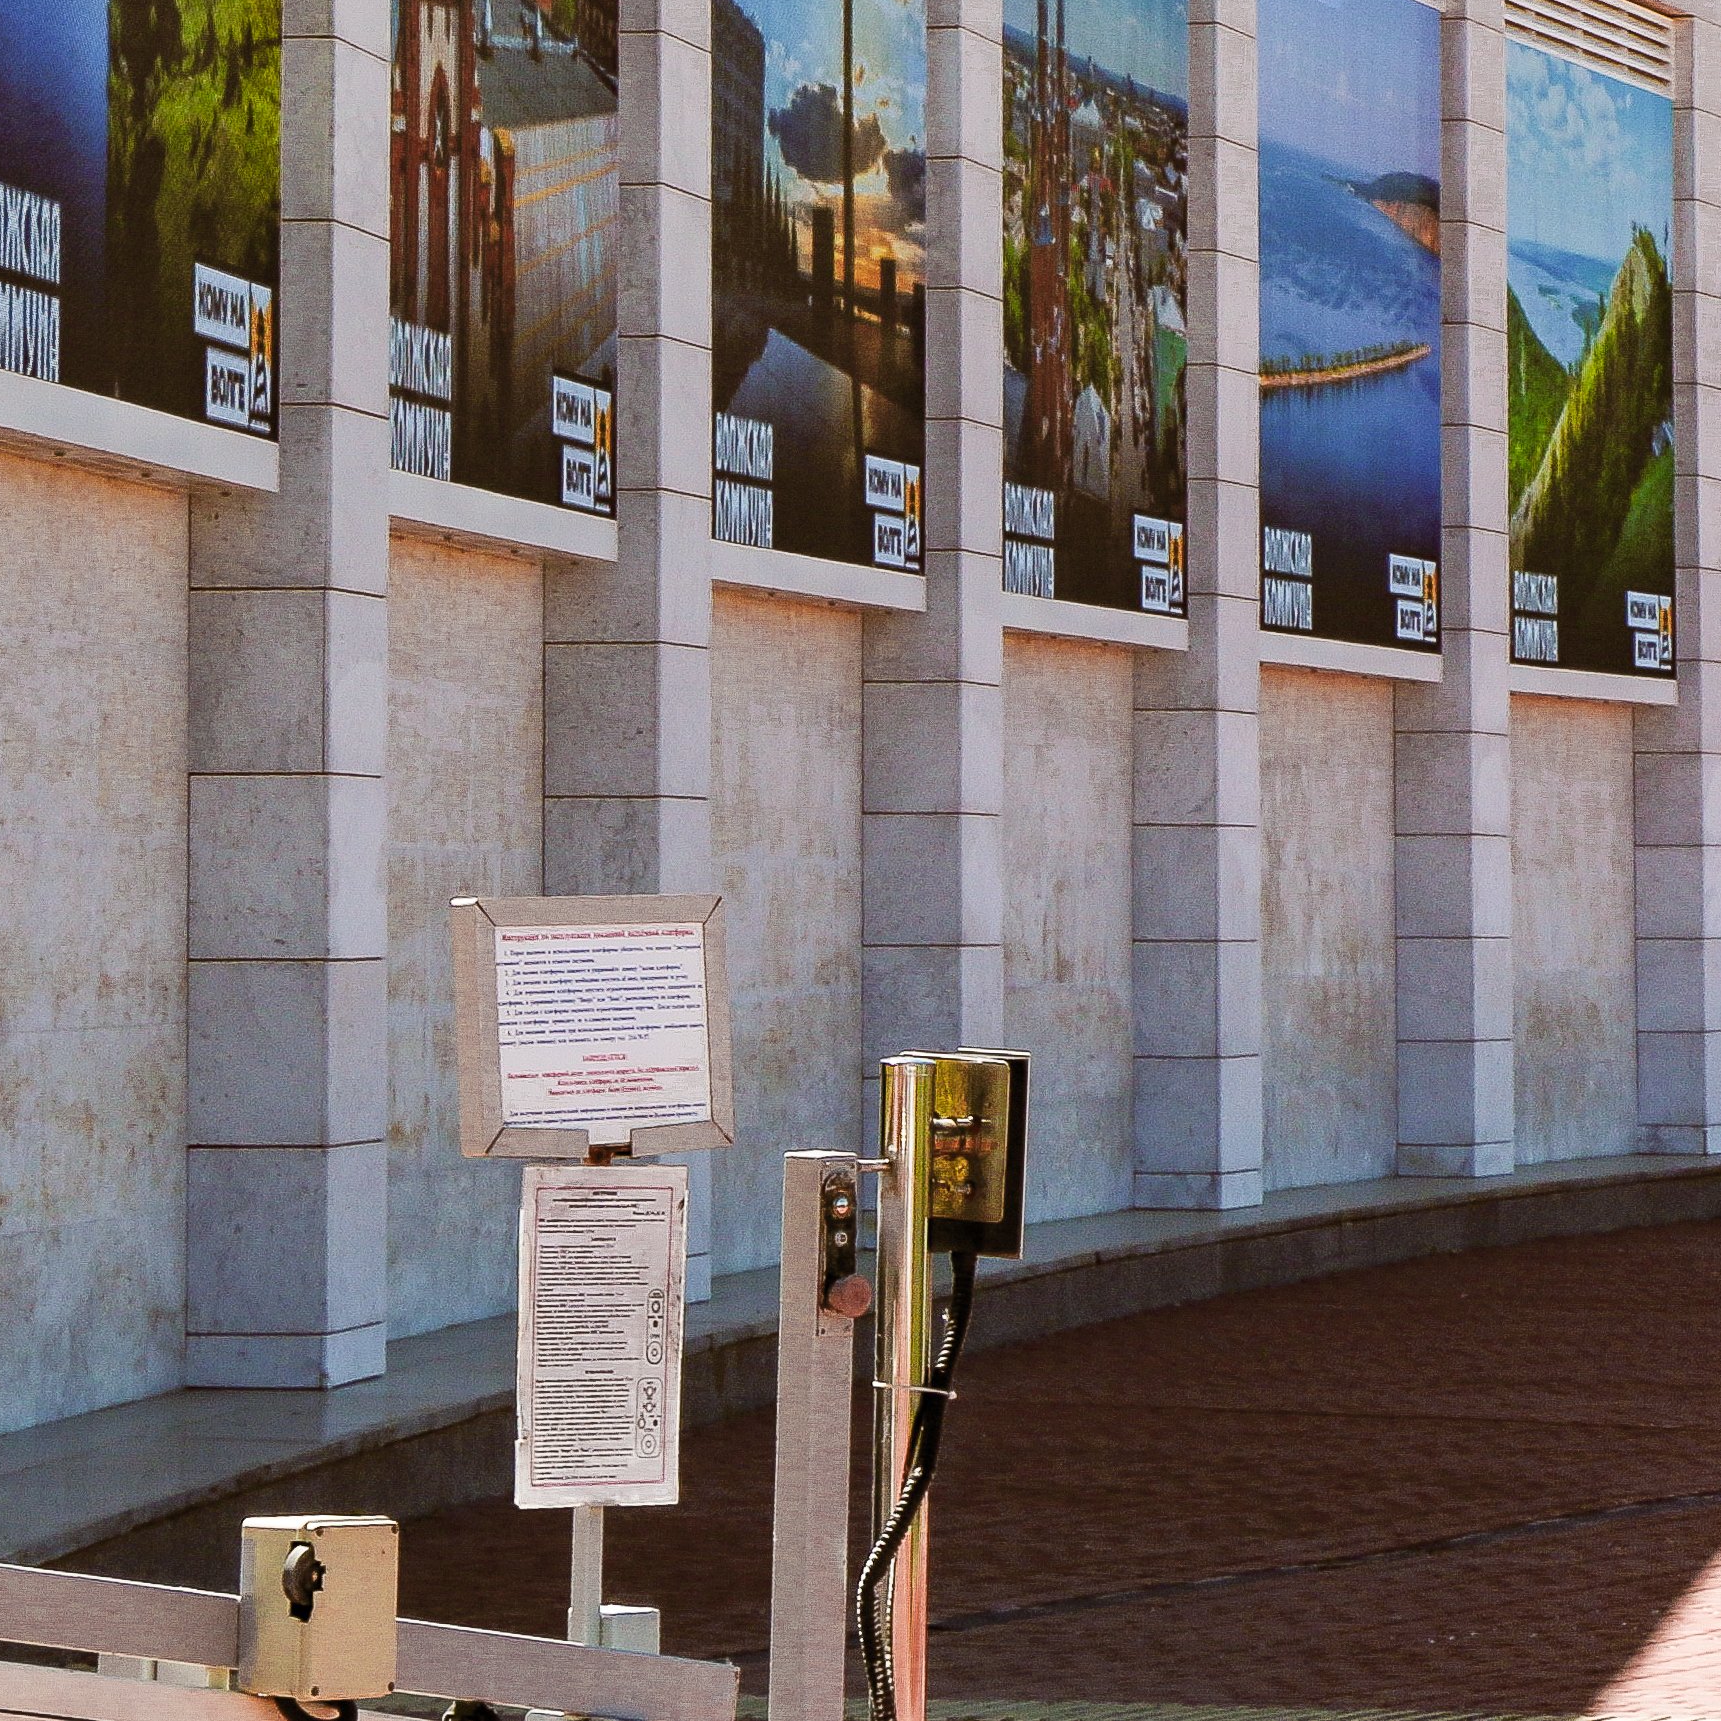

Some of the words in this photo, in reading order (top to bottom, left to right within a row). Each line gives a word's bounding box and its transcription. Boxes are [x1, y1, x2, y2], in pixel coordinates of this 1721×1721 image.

[199, 280, 227, 324] КОМУ
[230, 291, 245, 330] НА
[211, 362, 244, 413] ВОЛГЕ
[389, 316, 451, 401] ВОЛЖСКАЯ
[389, 395, 451, 482] КОММУНА
[716, 412, 772, 481] ВОЛЖСКАЯ
[715, 479, 772, 548] КОММУНА
